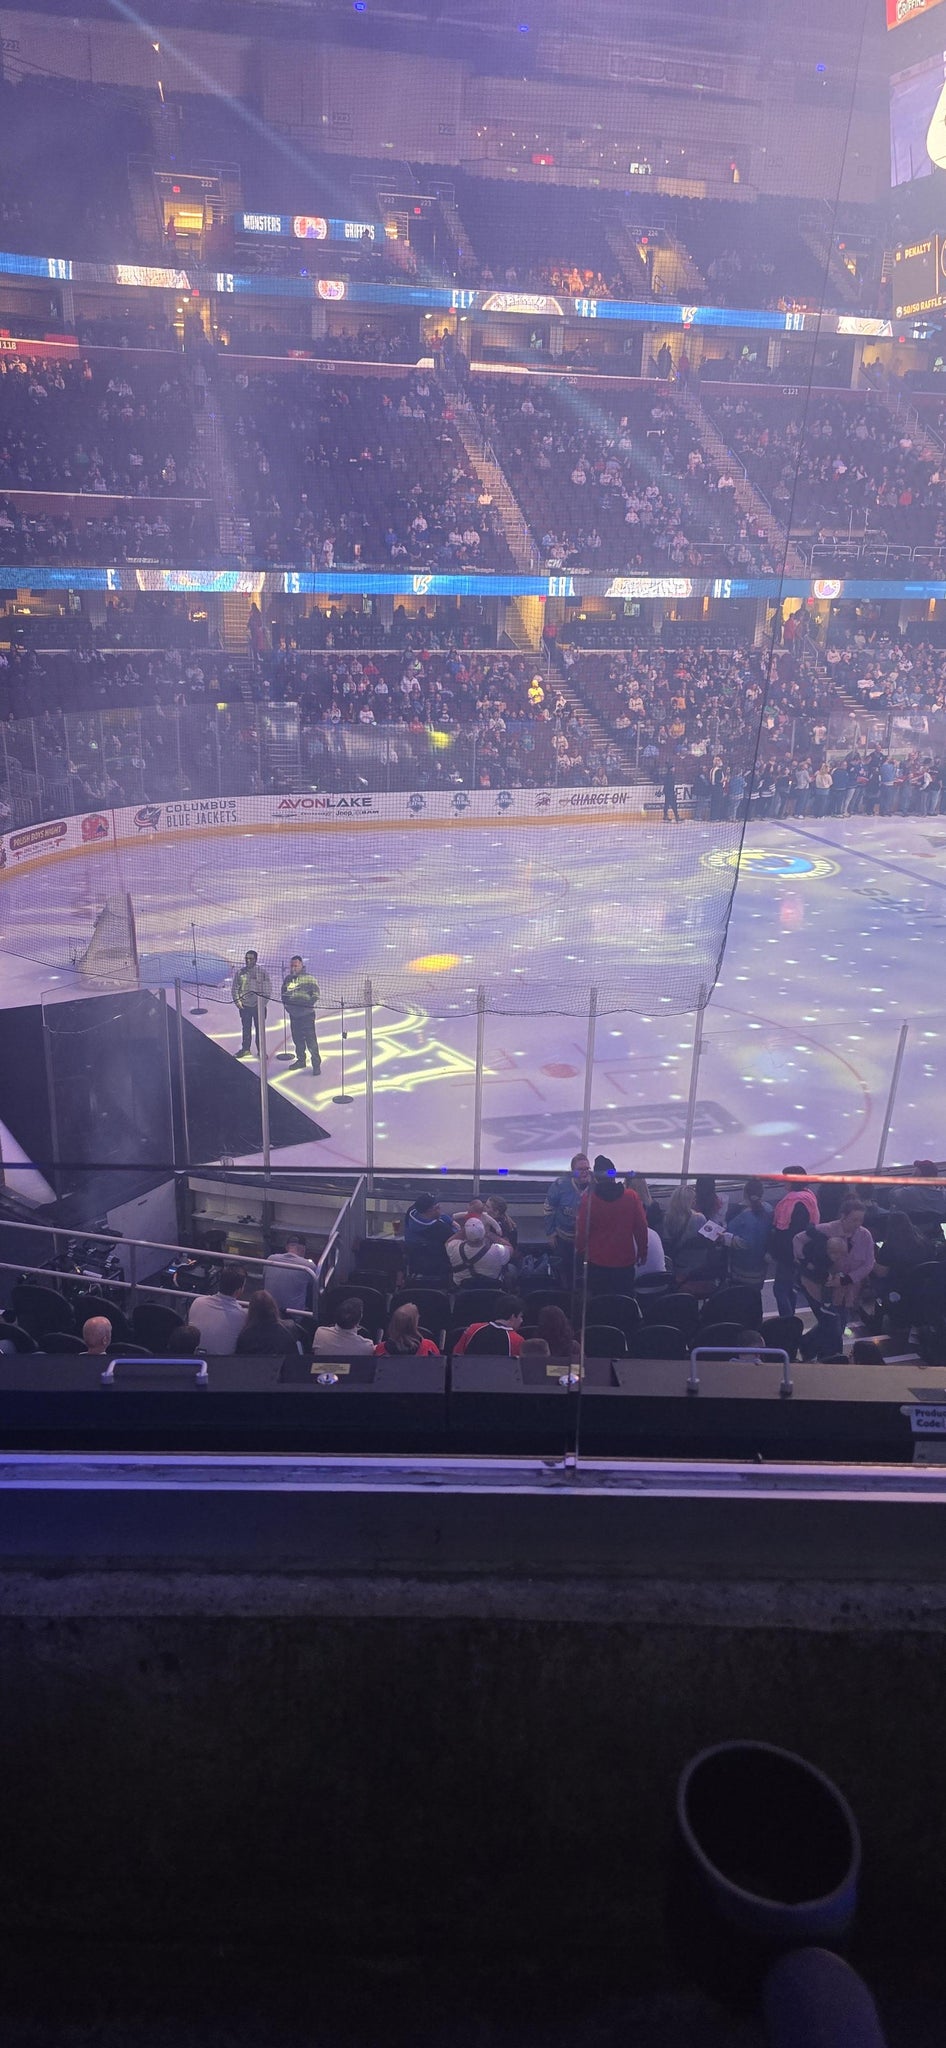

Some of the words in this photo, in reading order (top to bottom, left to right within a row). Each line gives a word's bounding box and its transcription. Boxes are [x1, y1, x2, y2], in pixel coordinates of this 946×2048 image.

[243, 213, 281, 232] MONSTERS
[904, 242, 932, 259] PENALTY
[920, 296, 943, 311] RAFFLE
[165, 800, 236, 813] COLUMBUS
[278, 797, 373, 809] AVONLAKE
[571, 793, 609, 806] CHARGE
[166, 812, 191, 828] BLUE
[193, 810, 237, 825] JACKETS
[917, 1419, 941, 1428] Code
